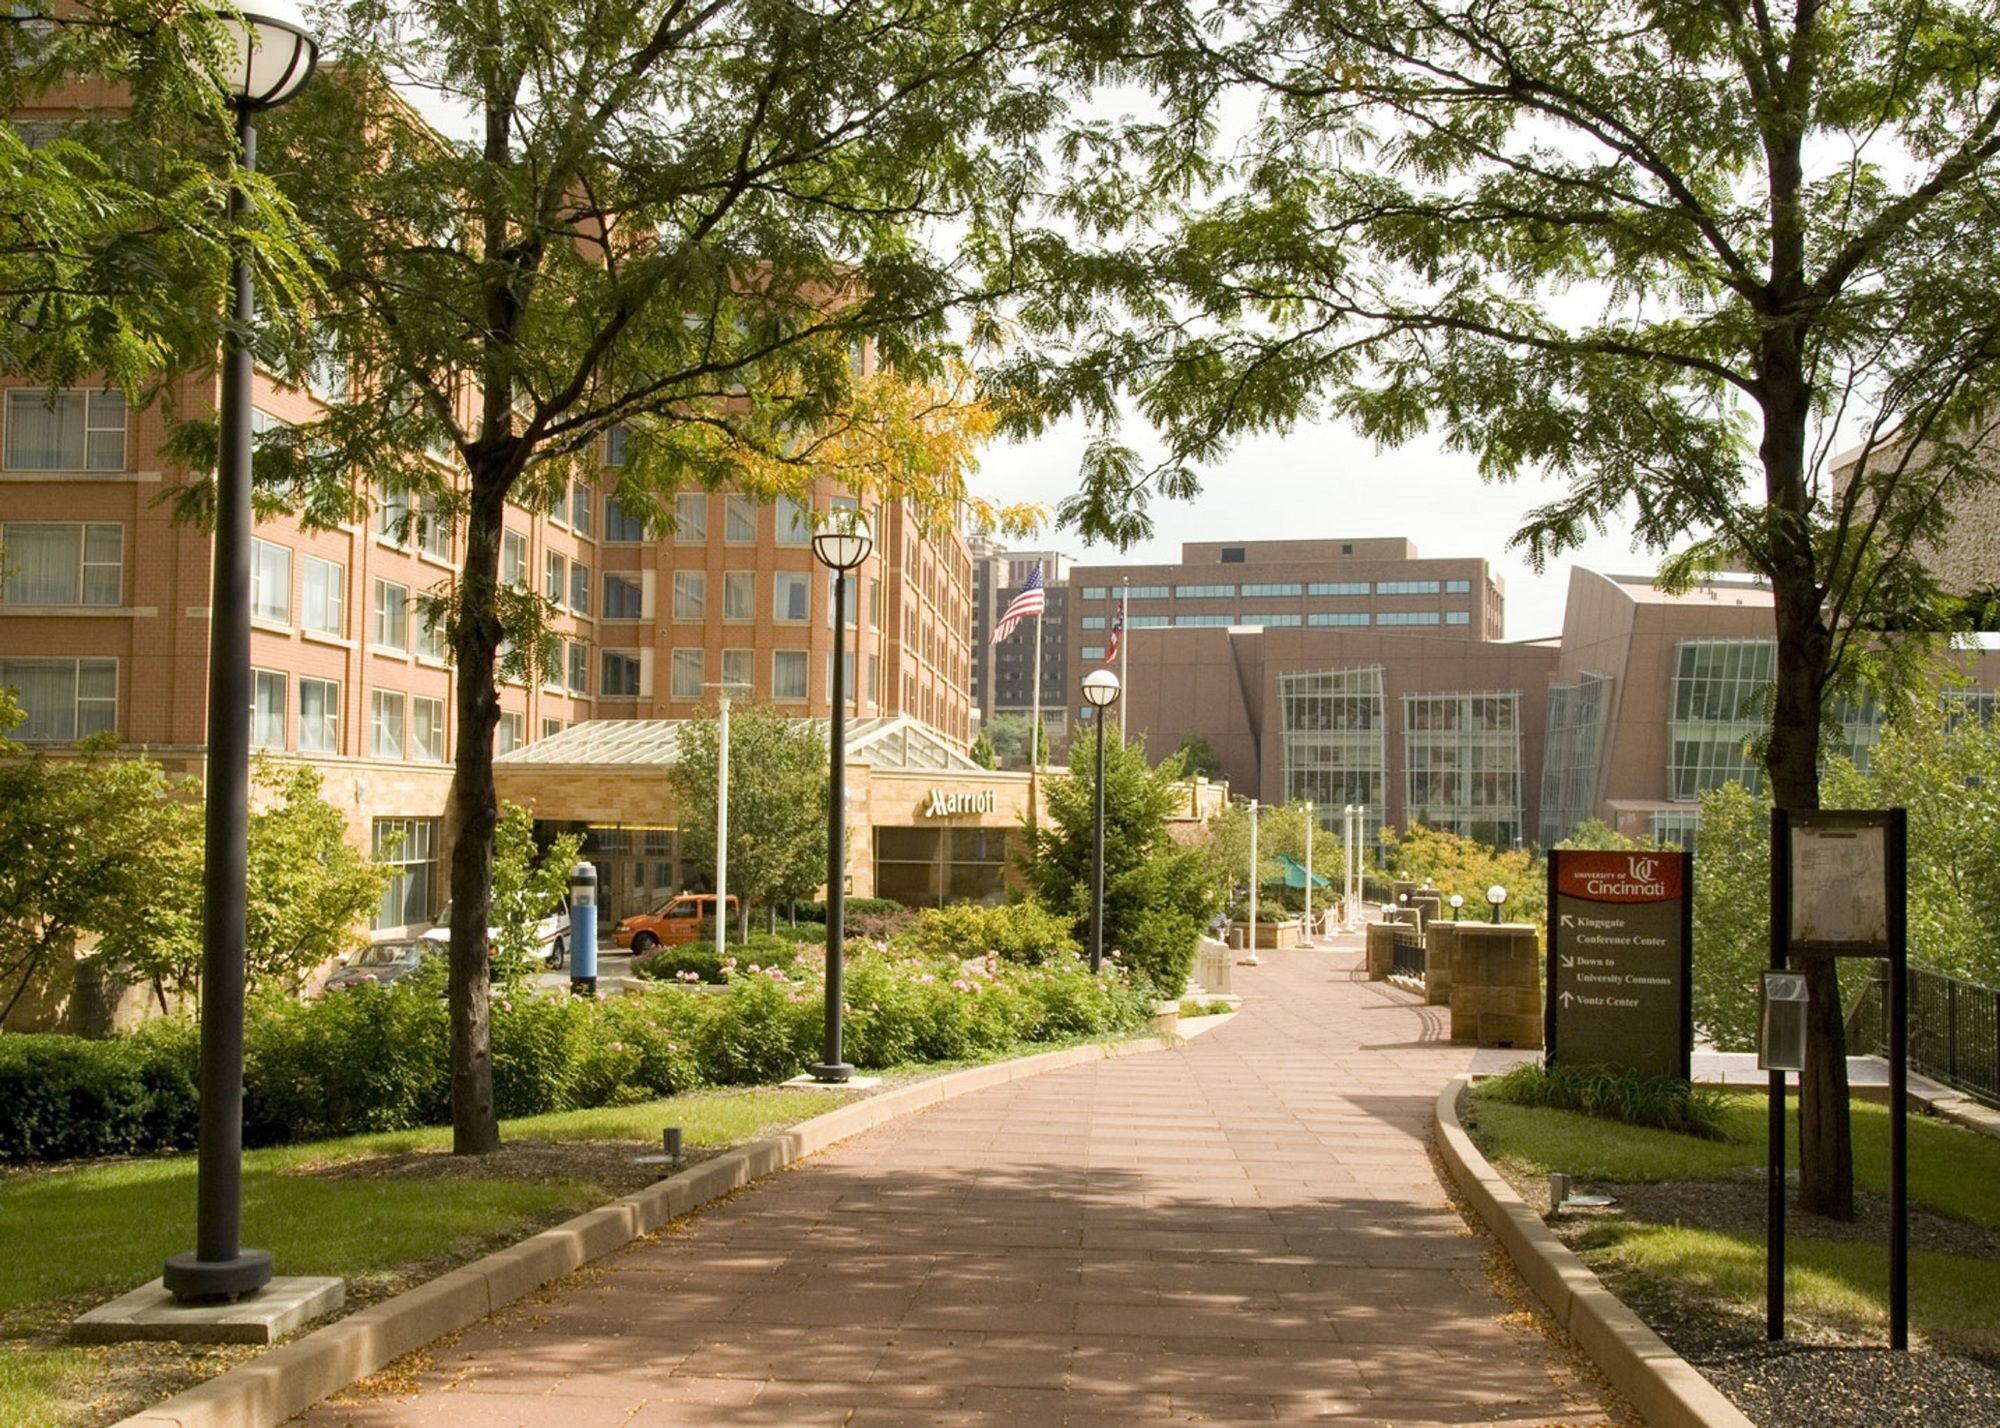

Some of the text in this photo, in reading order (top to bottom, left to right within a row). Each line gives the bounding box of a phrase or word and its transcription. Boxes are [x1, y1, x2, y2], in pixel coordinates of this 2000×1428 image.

[925, 786, 996, 817] Marriott
[1587, 880, 1665, 896] Cincinnati
[1577, 918, 1625, 929] Kingsgate
[1576, 934, 1667, 946] Conference Center
[1576, 956, 1615, 967] Down to
[1576, 973, 1671, 985] University Commons
[1576, 995, 1640, 1007] Vontz Center
